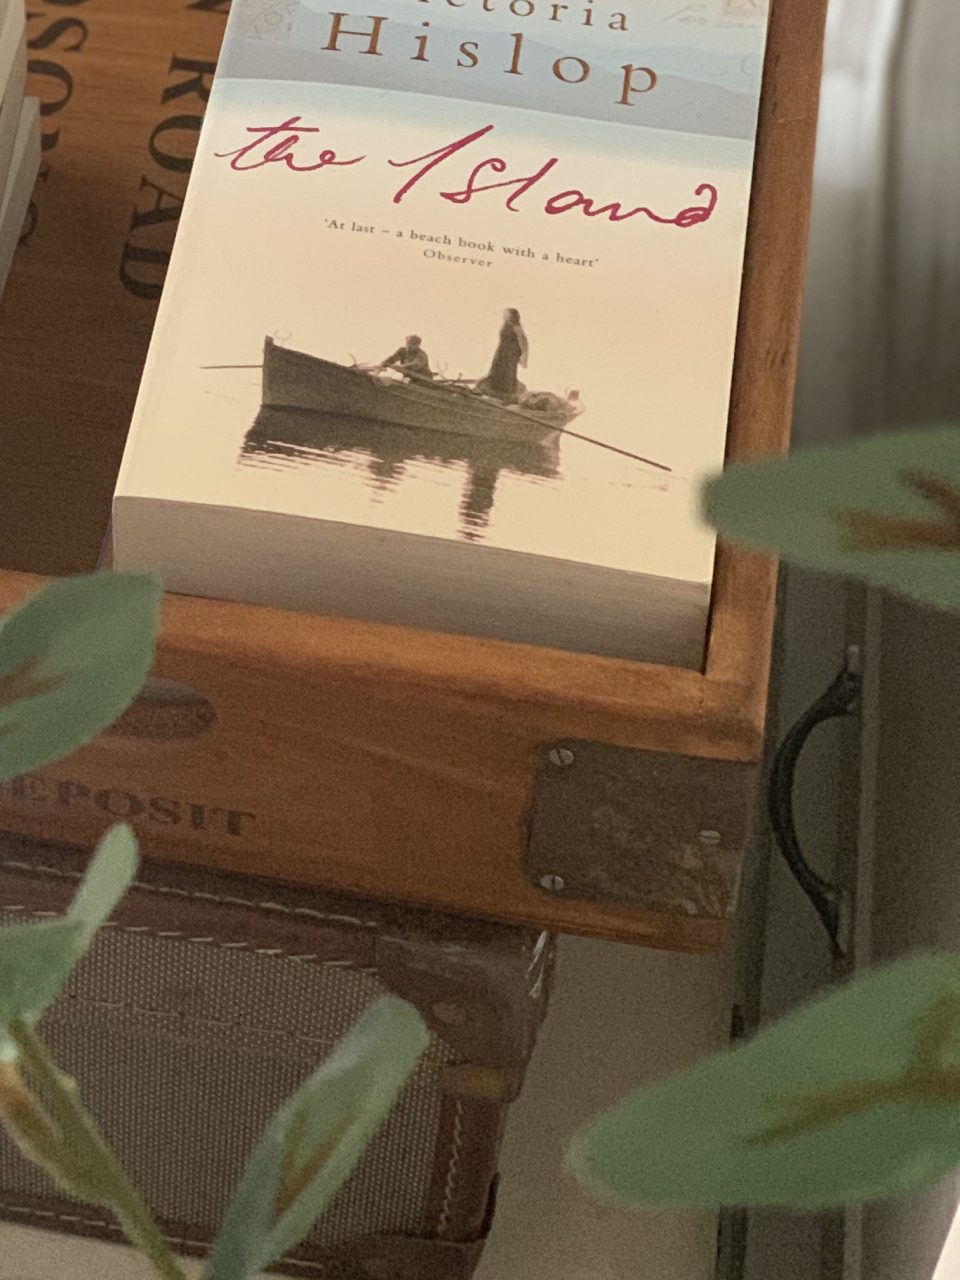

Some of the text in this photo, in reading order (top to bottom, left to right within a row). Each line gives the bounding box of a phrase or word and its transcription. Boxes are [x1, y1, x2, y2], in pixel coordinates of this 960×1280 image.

[319, 10, 659, 108] Hislop
[214, 116, 719, 228] the Island
[351, 221, 376, 235] last
[396, 229, 404, 239] a
[409, 229, 452, 246] beach
[457, 236, 496, 253] book
[502, 243, 536, 260] with
[541, 251, 550, 262] a
[555, 251, 600, 269] heart'
[422, 248, 494, 269] Observer
[11, 774, 257, 838] EPOSIT
